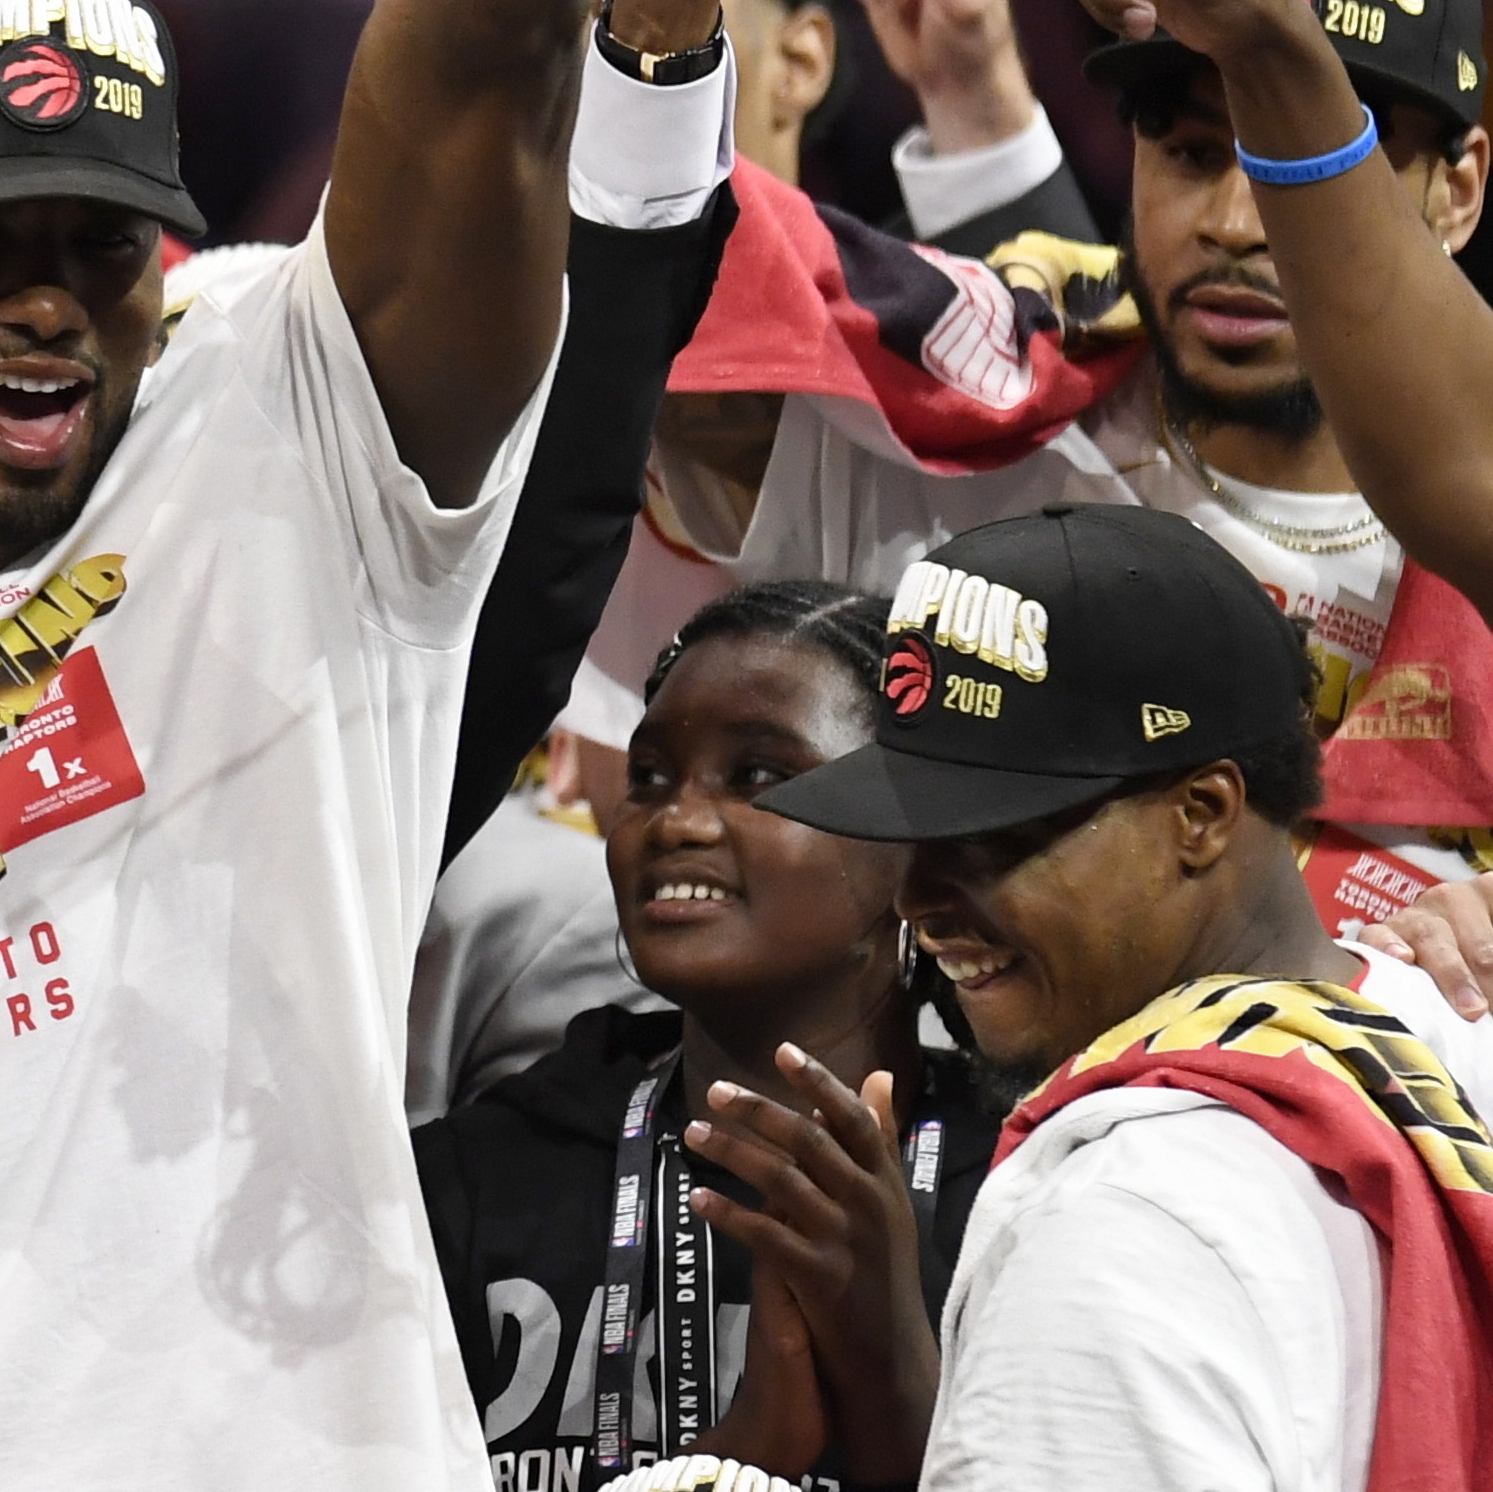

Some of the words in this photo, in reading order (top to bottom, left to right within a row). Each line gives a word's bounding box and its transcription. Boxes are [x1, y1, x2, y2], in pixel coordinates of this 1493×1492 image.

[93, 74, 144, 120] 2019
[942, 674, 1003, 719] 2019
[615, 1174, 641, 1214] FINALS
[677, 1171, 691, 1225] SPORT
[612, 1212, 637, 1239] NBA
[675, 1231, 697, 1303] DKNY
[604, 1283, 630, 1322] FINALS
[602, 1321, 626, 1345] NBA
[681, 1317, 693, 1370] SPORT
[597, 1392, 621, 1431] FINALS
[597, 1431, 620, 1457] NBA
